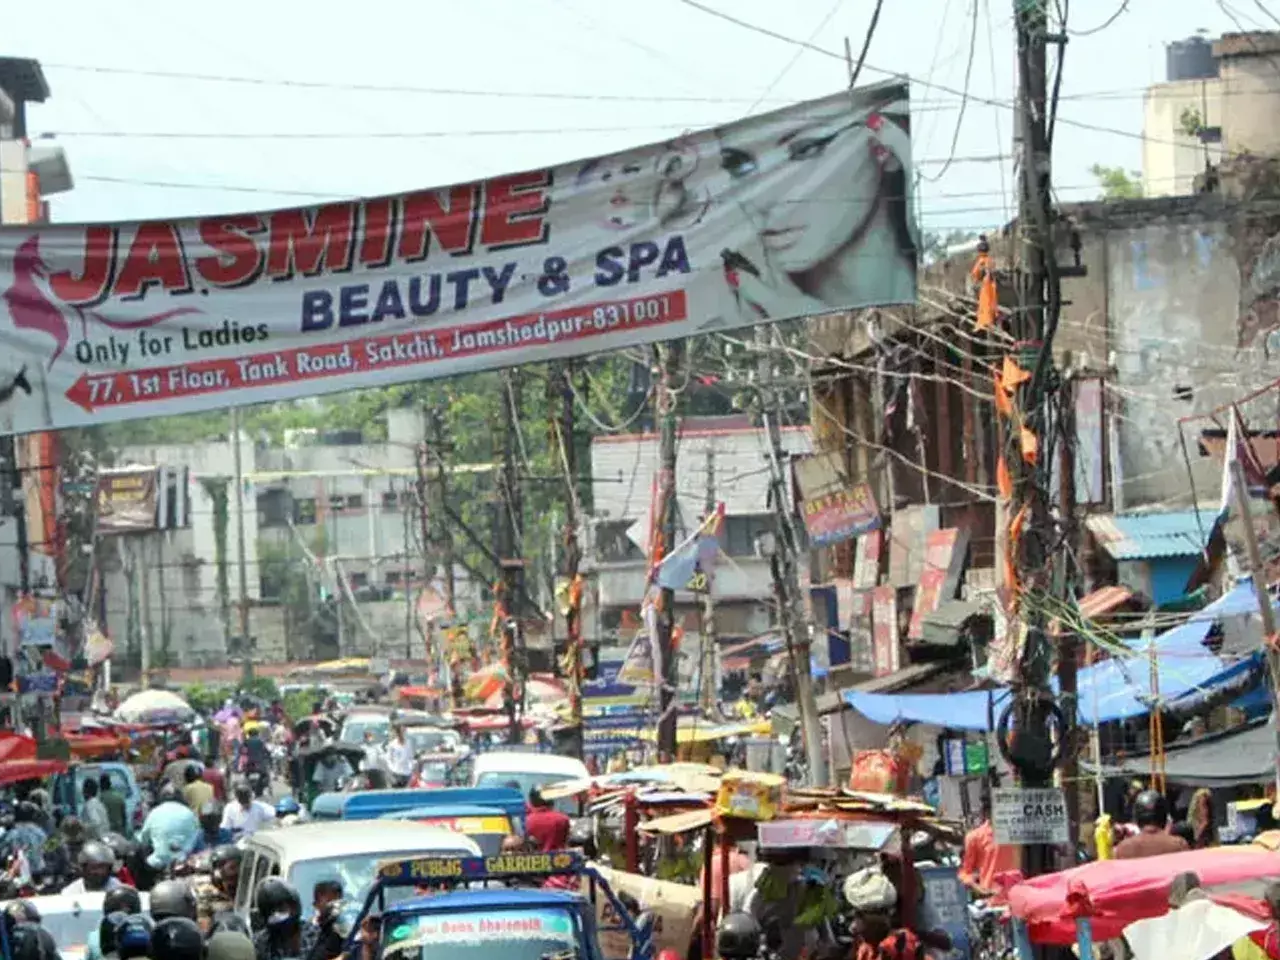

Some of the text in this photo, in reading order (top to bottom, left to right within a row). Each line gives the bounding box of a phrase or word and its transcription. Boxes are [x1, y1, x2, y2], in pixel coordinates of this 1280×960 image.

[50, 169, 553, 306] JASMINE
[301, 236, 691, 332] BEAUTY & SPA
[75, 320, 269, 365] Only for Ladies
[87, 298, 669, 401] 77, 1st Floor, Tank Road, Sakchi, Jamshedpur-831001
